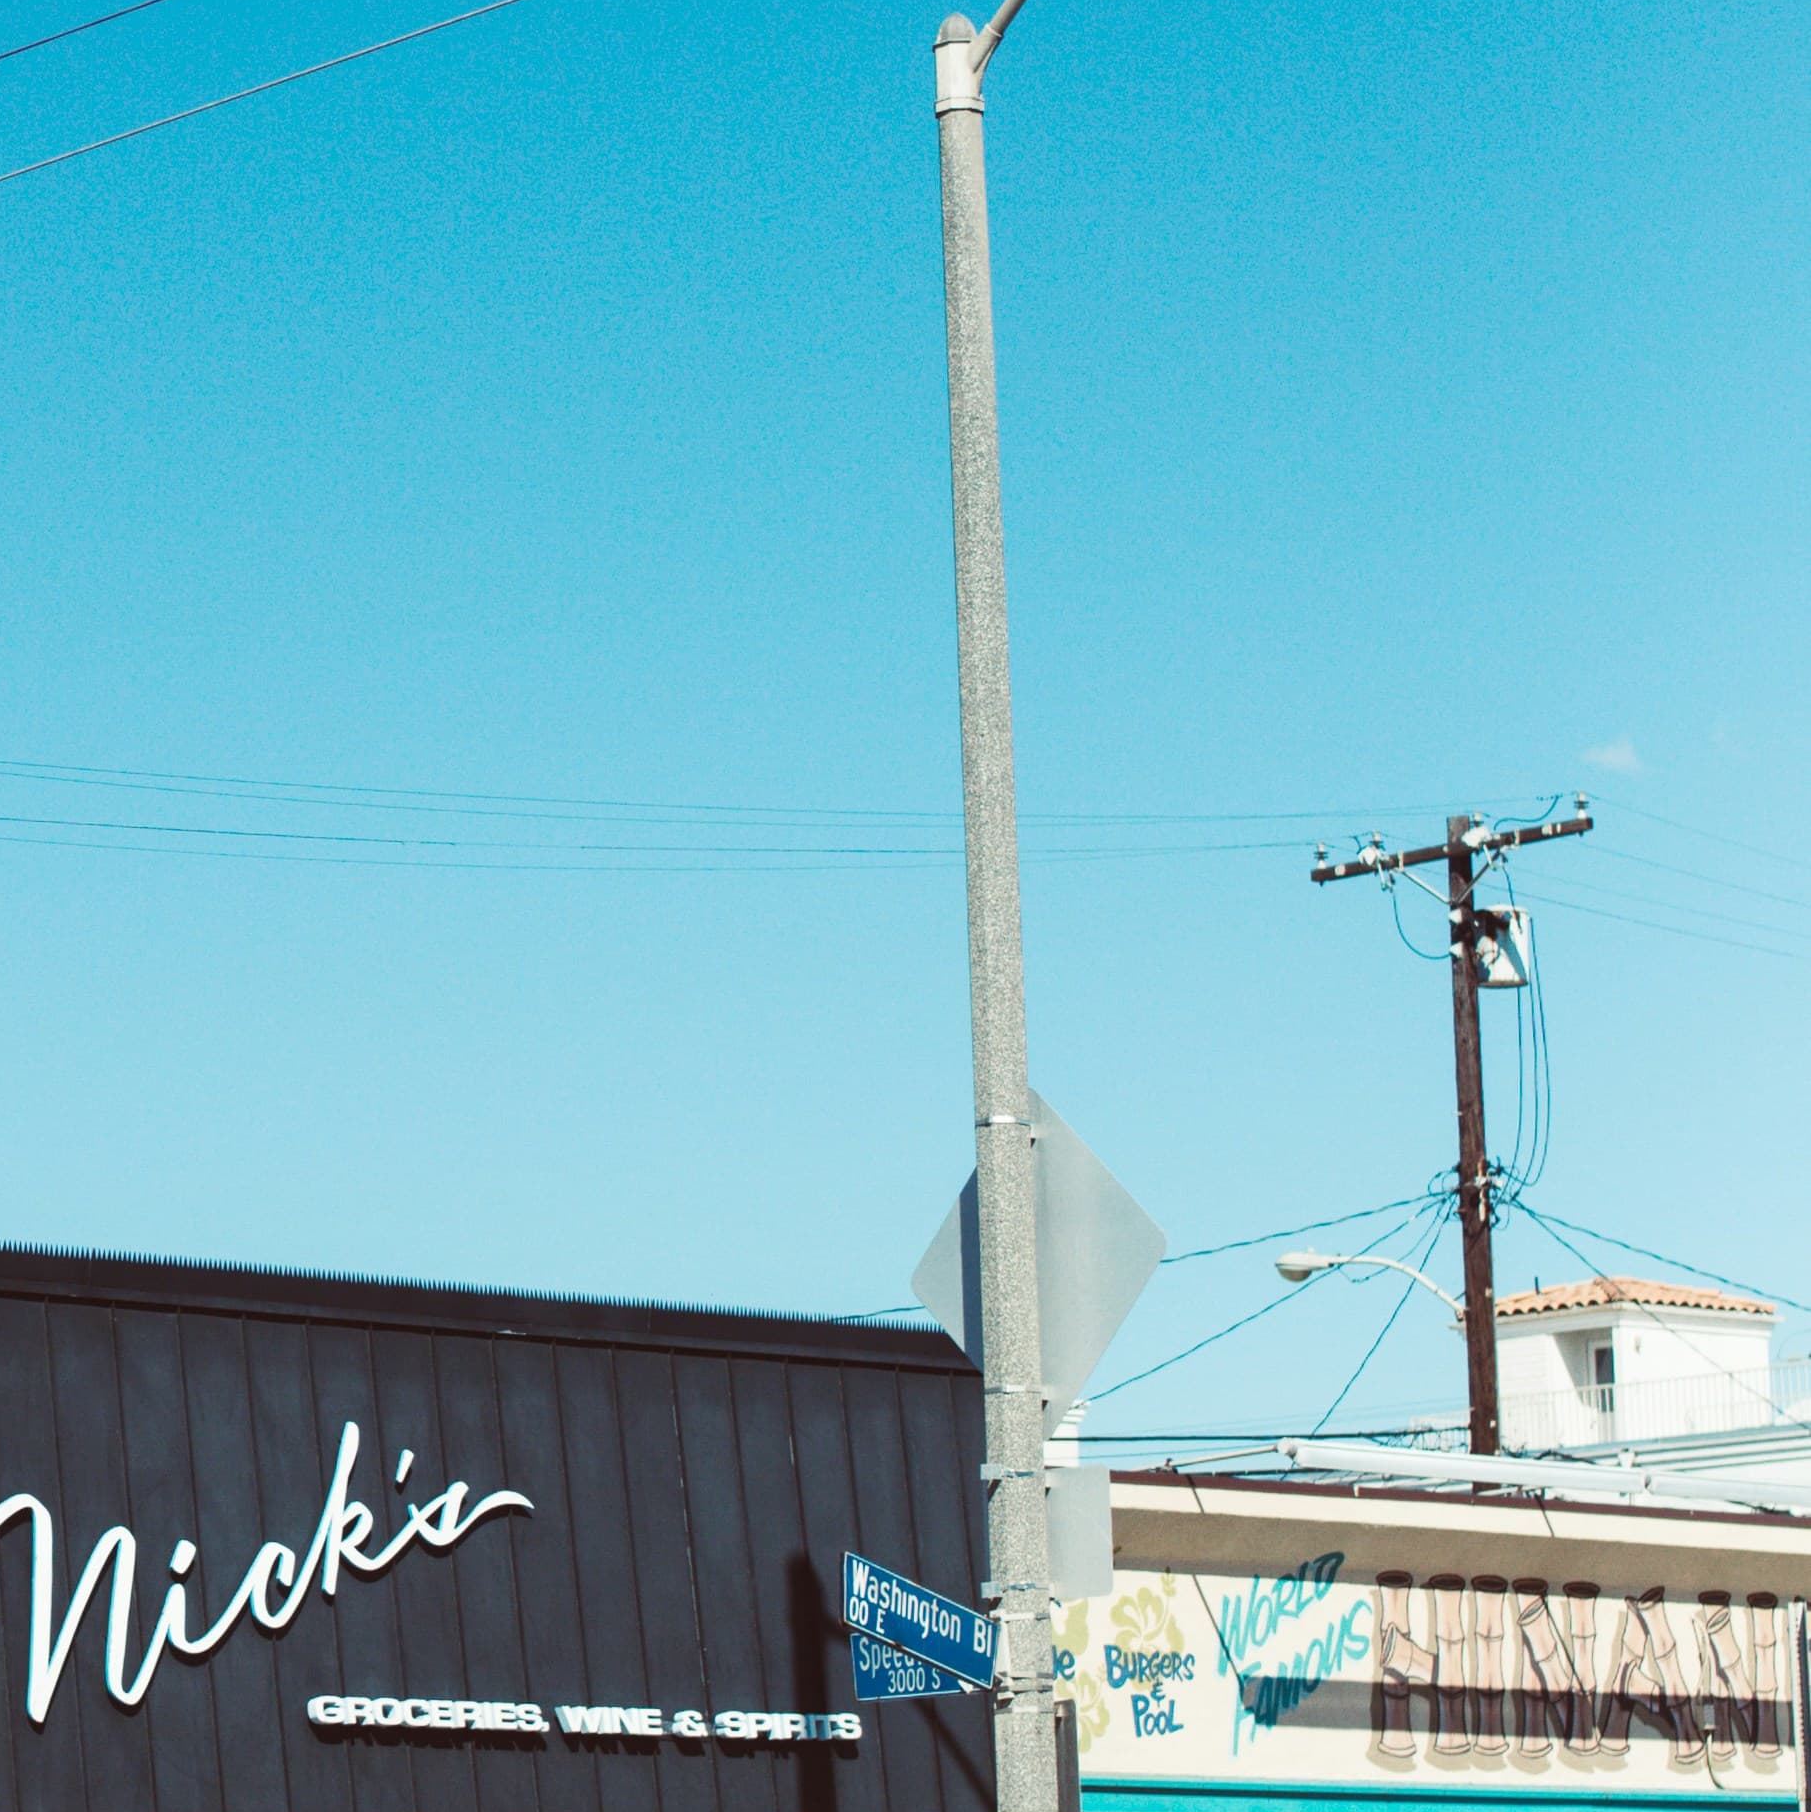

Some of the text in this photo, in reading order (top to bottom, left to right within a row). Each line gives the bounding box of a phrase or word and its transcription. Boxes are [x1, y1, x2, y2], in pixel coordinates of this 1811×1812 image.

[850, 1596, 886, 1634] 00 E
[852, 1560, 961, 1643] Washington
[1218, 1551, 1345, 1677] WORLD
[888, 1667, 941, 1693] 3000 S
[1233, 1600, 1373, 1758] FAMOUS
[555, 1702, 663, 1738] WINE
[672, 1710, 709, 1739] &
[715, 1710, 862, 1741] SPIRITS
[1131, 1694, 1184, 1738] POOL
